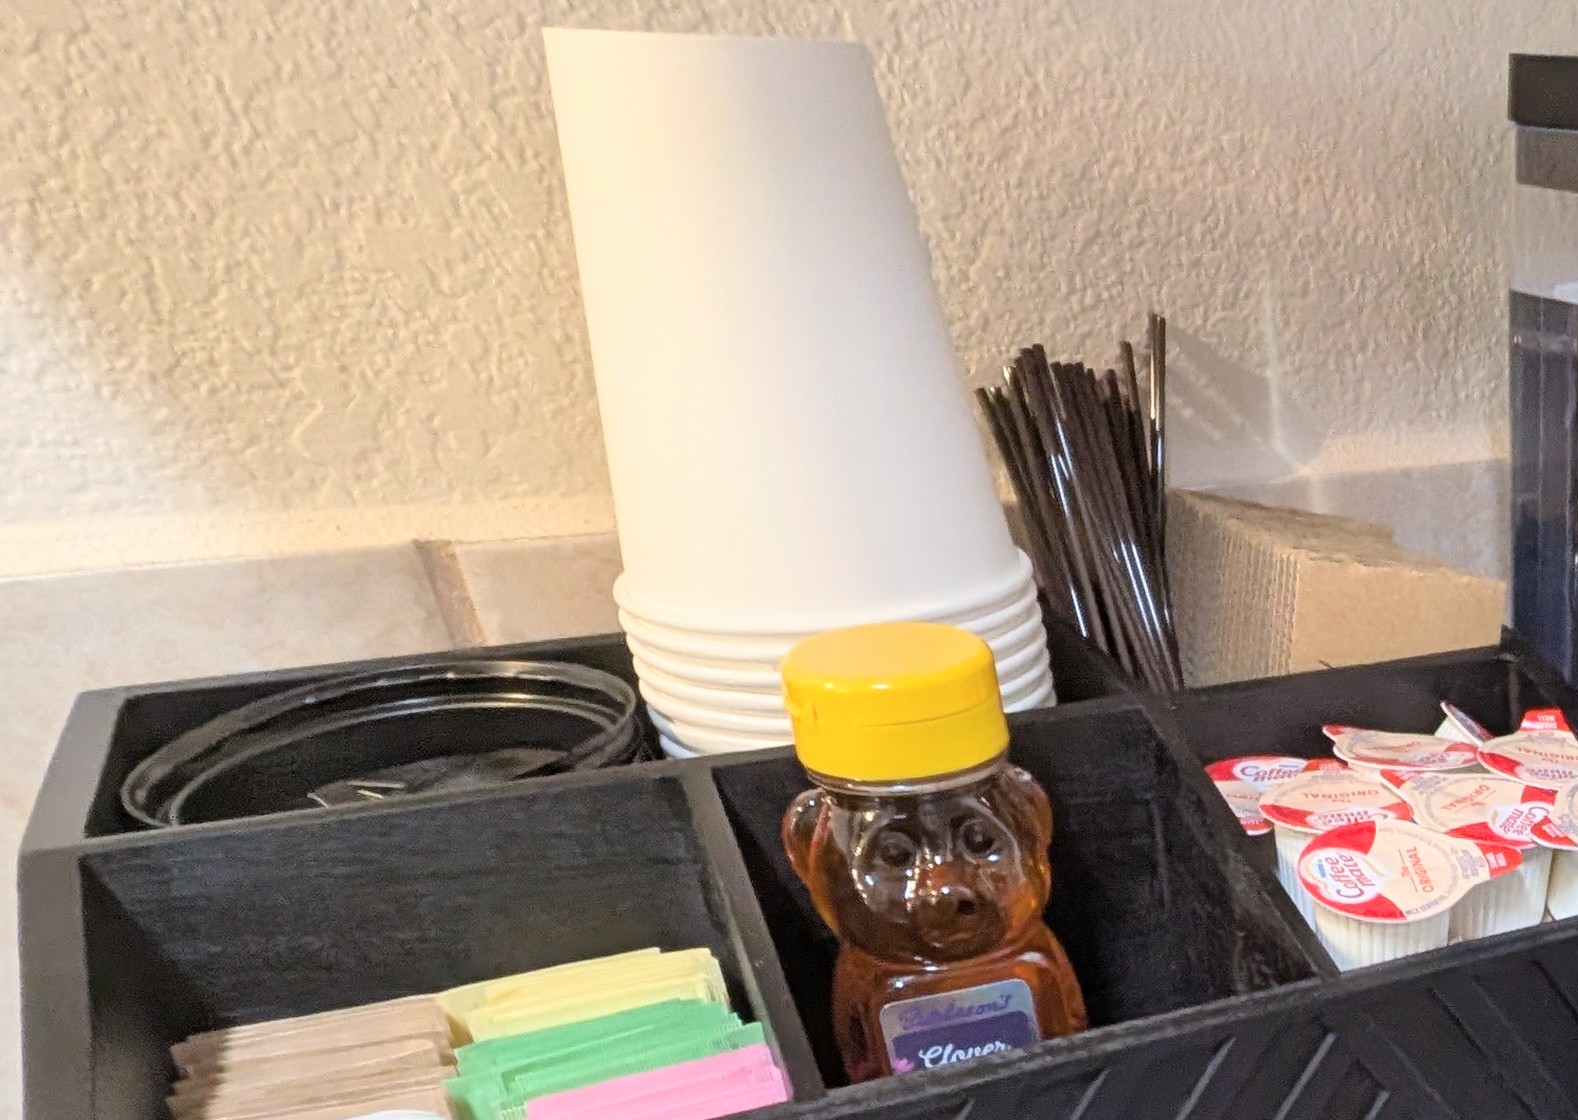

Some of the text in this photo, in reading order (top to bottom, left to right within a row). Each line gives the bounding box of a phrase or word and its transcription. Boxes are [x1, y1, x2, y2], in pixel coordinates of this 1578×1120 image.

[1302, 789, 1380, 799] ORIGINAL
[1441, 784, 1490, 809] ORIGINAL
[1325, 857, 1364, 898] Coffee
[1338, 852, 1375, 887] mate
[1406, 846, 1433, 893] ORIGINAL
